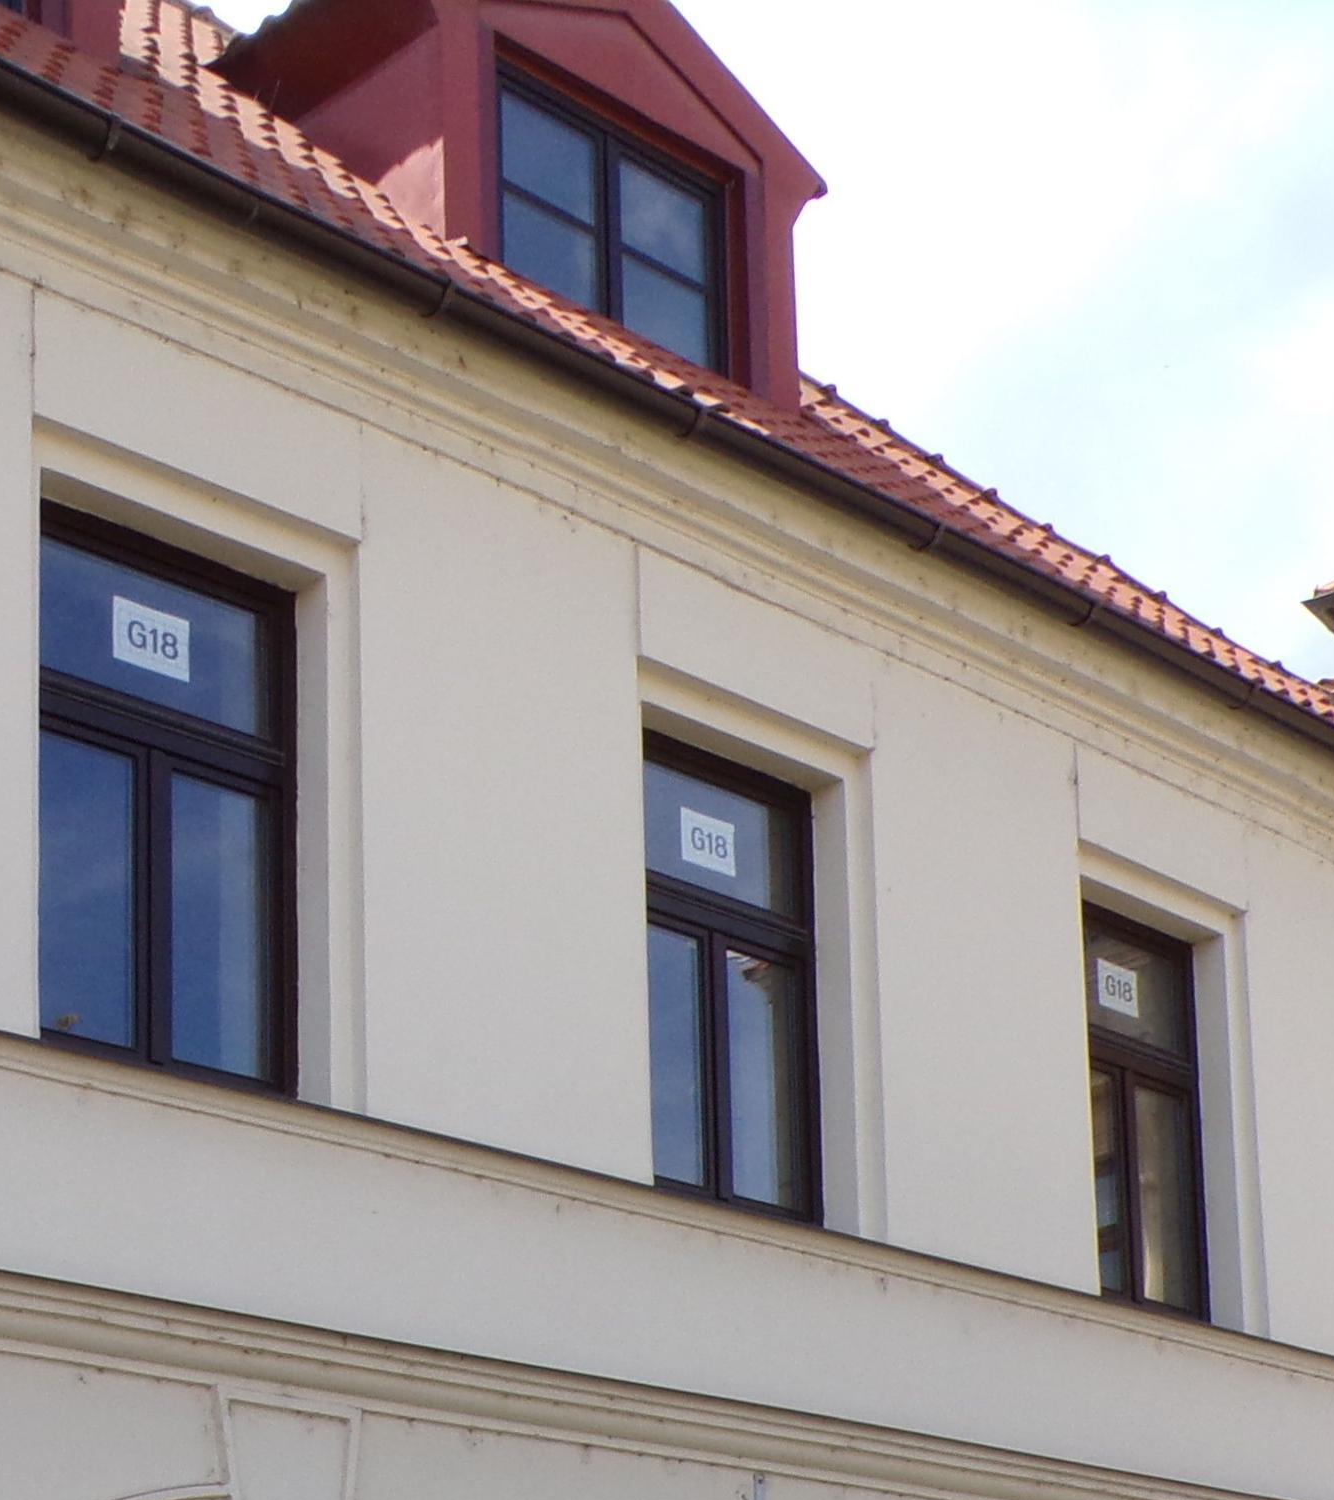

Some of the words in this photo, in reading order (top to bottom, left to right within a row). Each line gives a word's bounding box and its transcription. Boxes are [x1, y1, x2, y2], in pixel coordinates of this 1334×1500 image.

[128, 620, 178, 660] G18
[691, 827, 727, 859] G18
[1105, 975, 1133, 1002] G18
